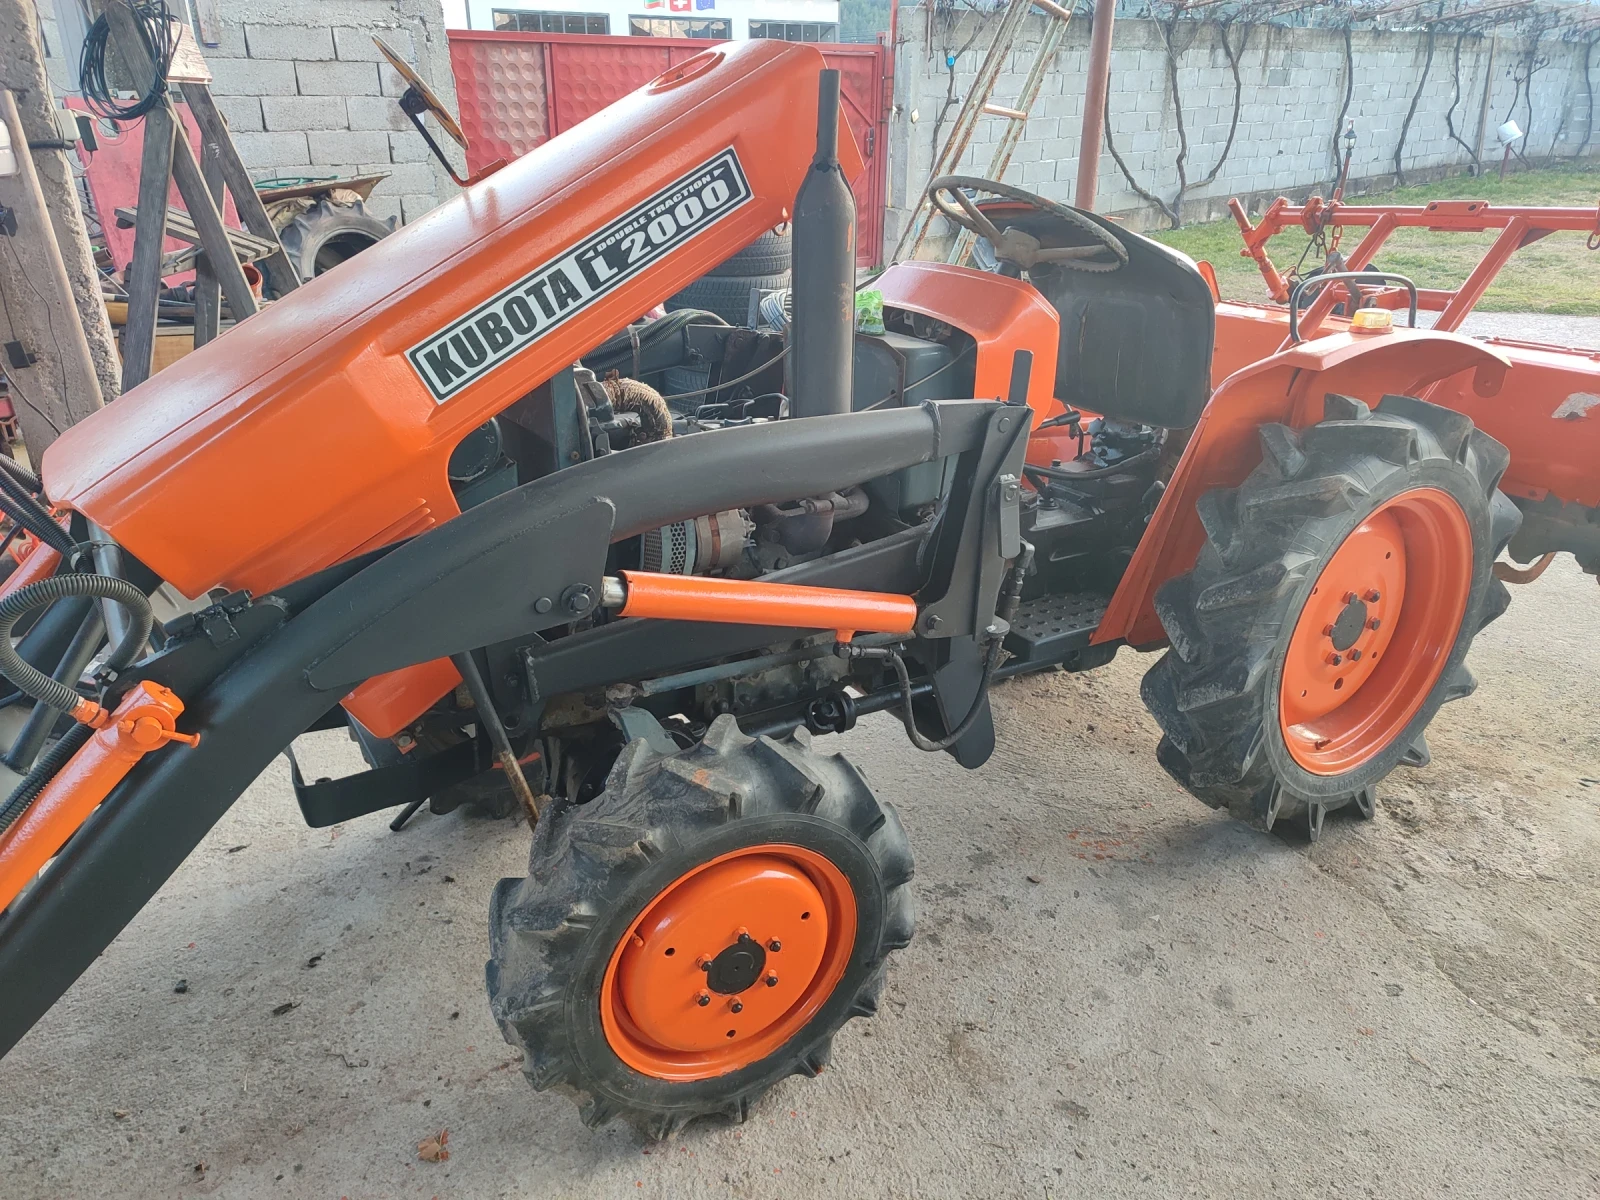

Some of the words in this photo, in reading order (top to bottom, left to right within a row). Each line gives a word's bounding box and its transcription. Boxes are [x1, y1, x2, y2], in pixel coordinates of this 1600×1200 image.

[423, 268, 583, 388] KUBOTA
[590, 255, 619, 283] L
[620, 179, 730, 265] 2000
[596, 215, 648, 253] DOUBLE
[647, 174, 712, 218] TRACTION
